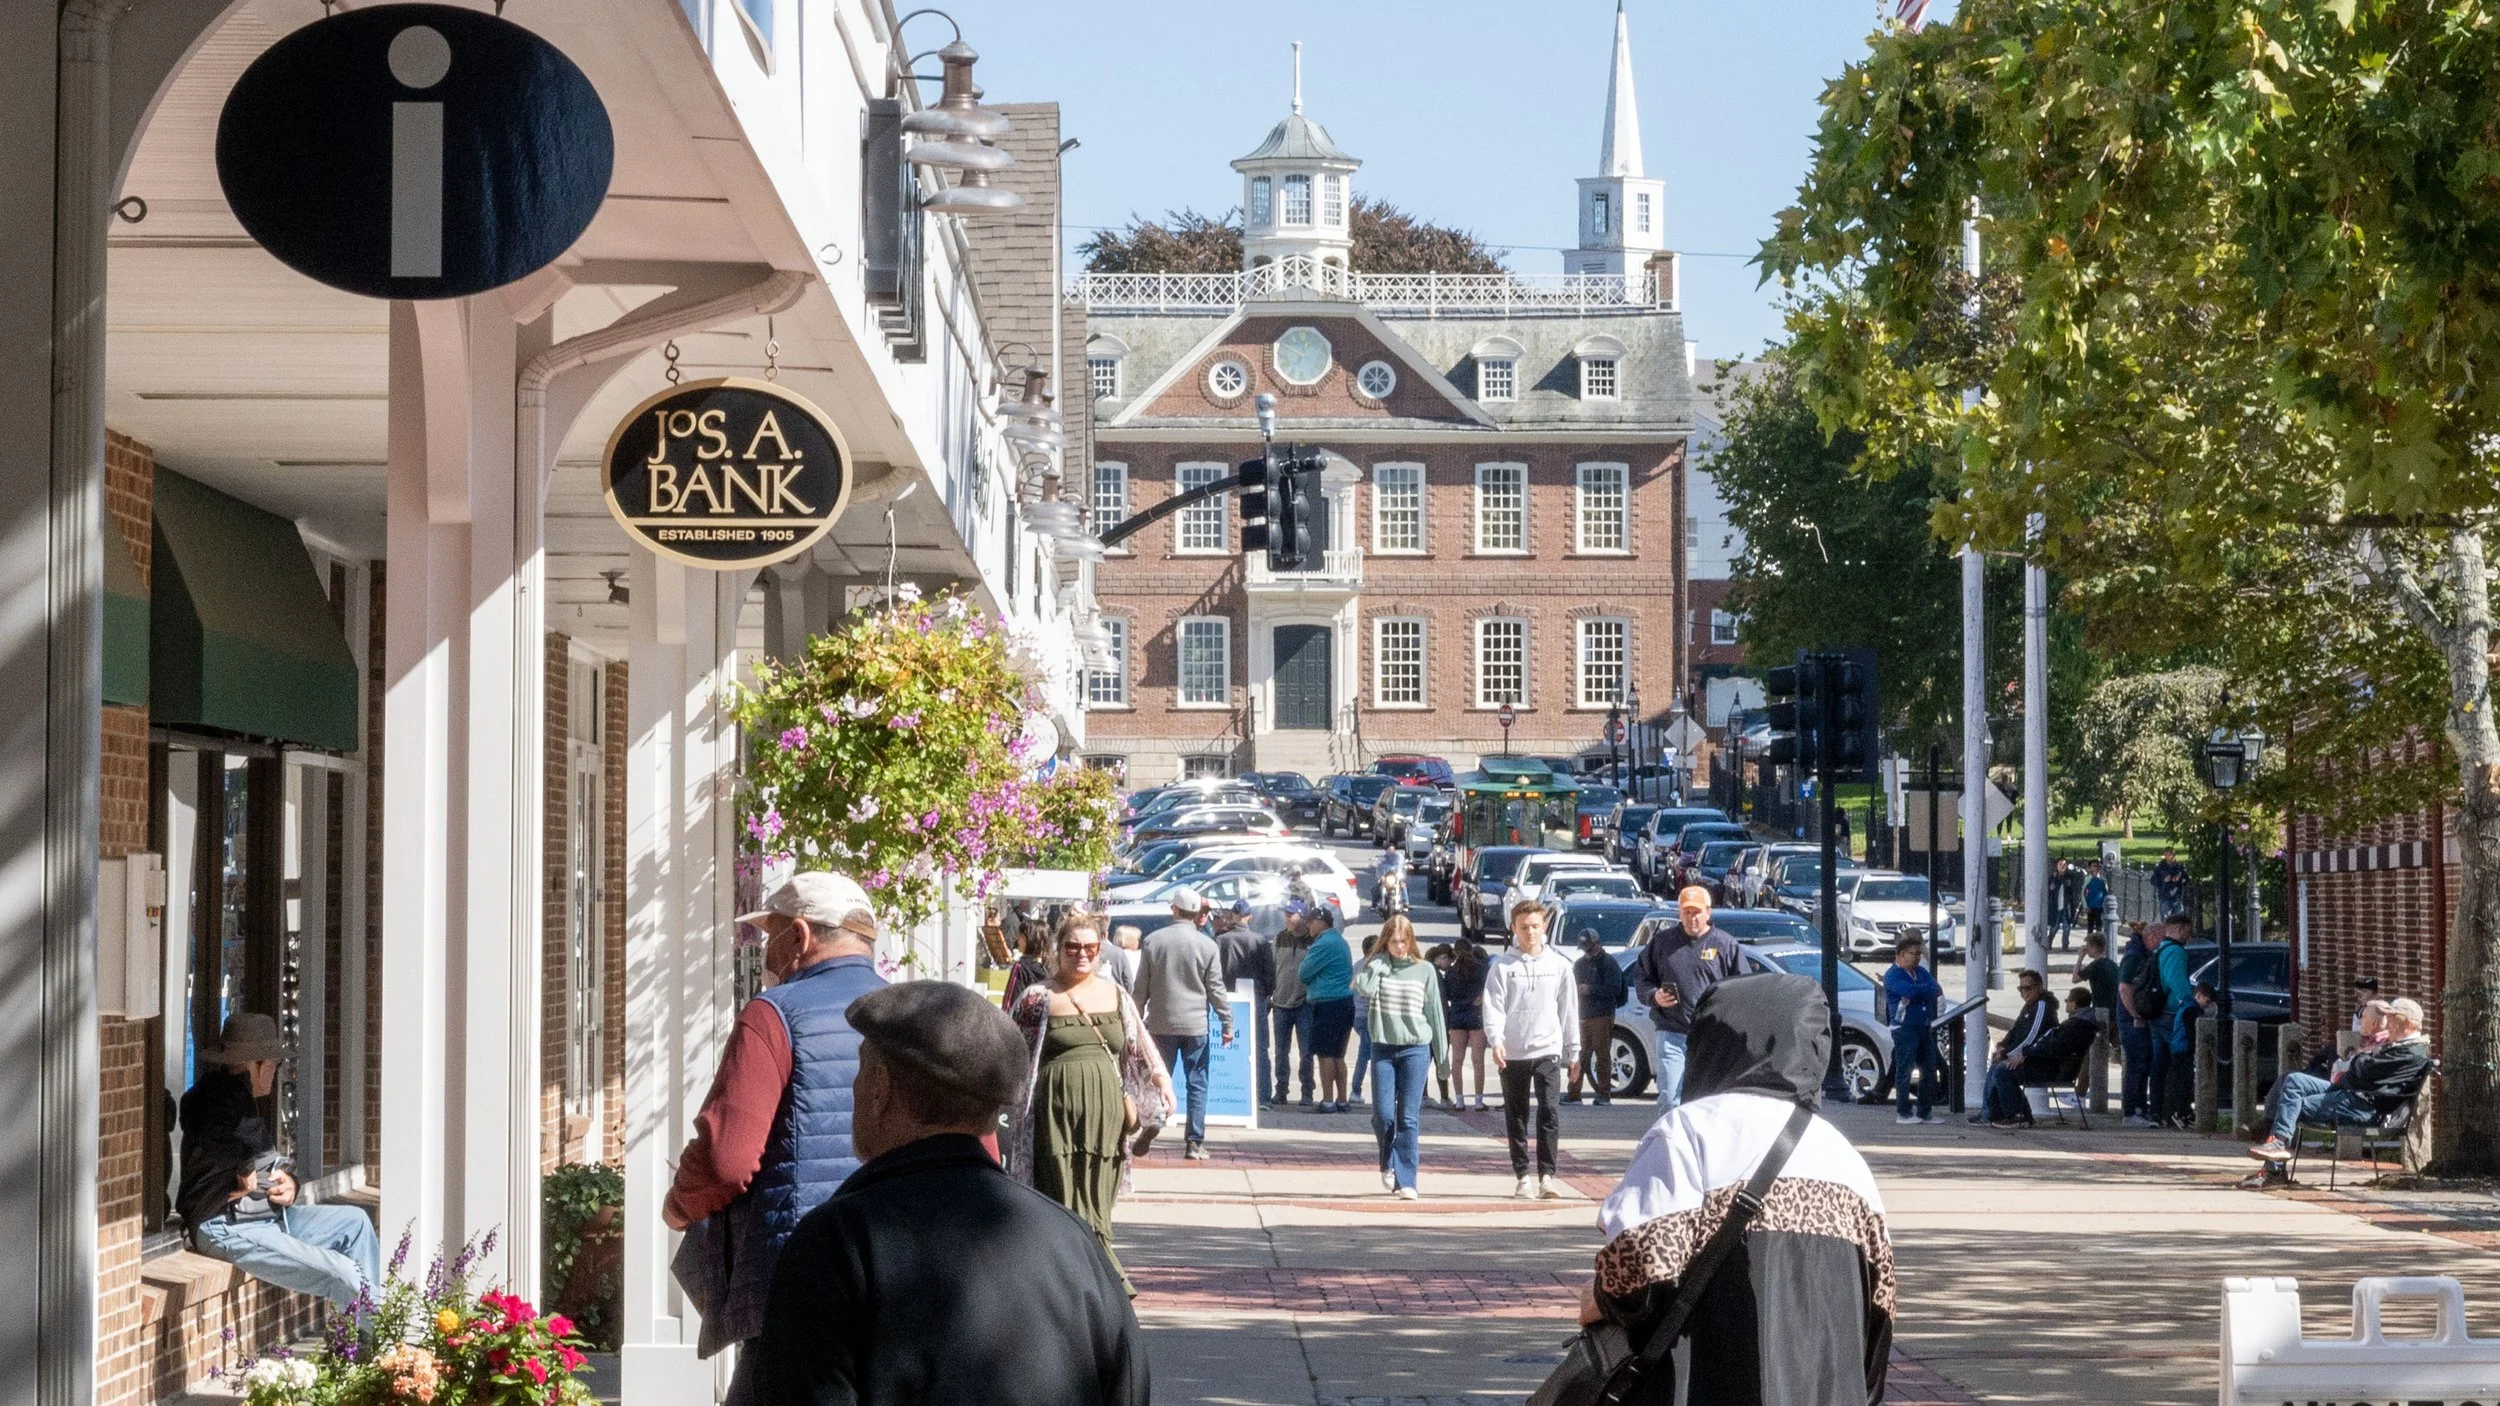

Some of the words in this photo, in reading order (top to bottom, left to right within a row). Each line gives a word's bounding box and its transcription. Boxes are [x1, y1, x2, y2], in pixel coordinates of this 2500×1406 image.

[743, 410, 803, 460] A.
[648, 464, 816, 515] BANK
[659, 529, 755, 541] ESTABLISHED
[761, 529, 795, 541] 1905
